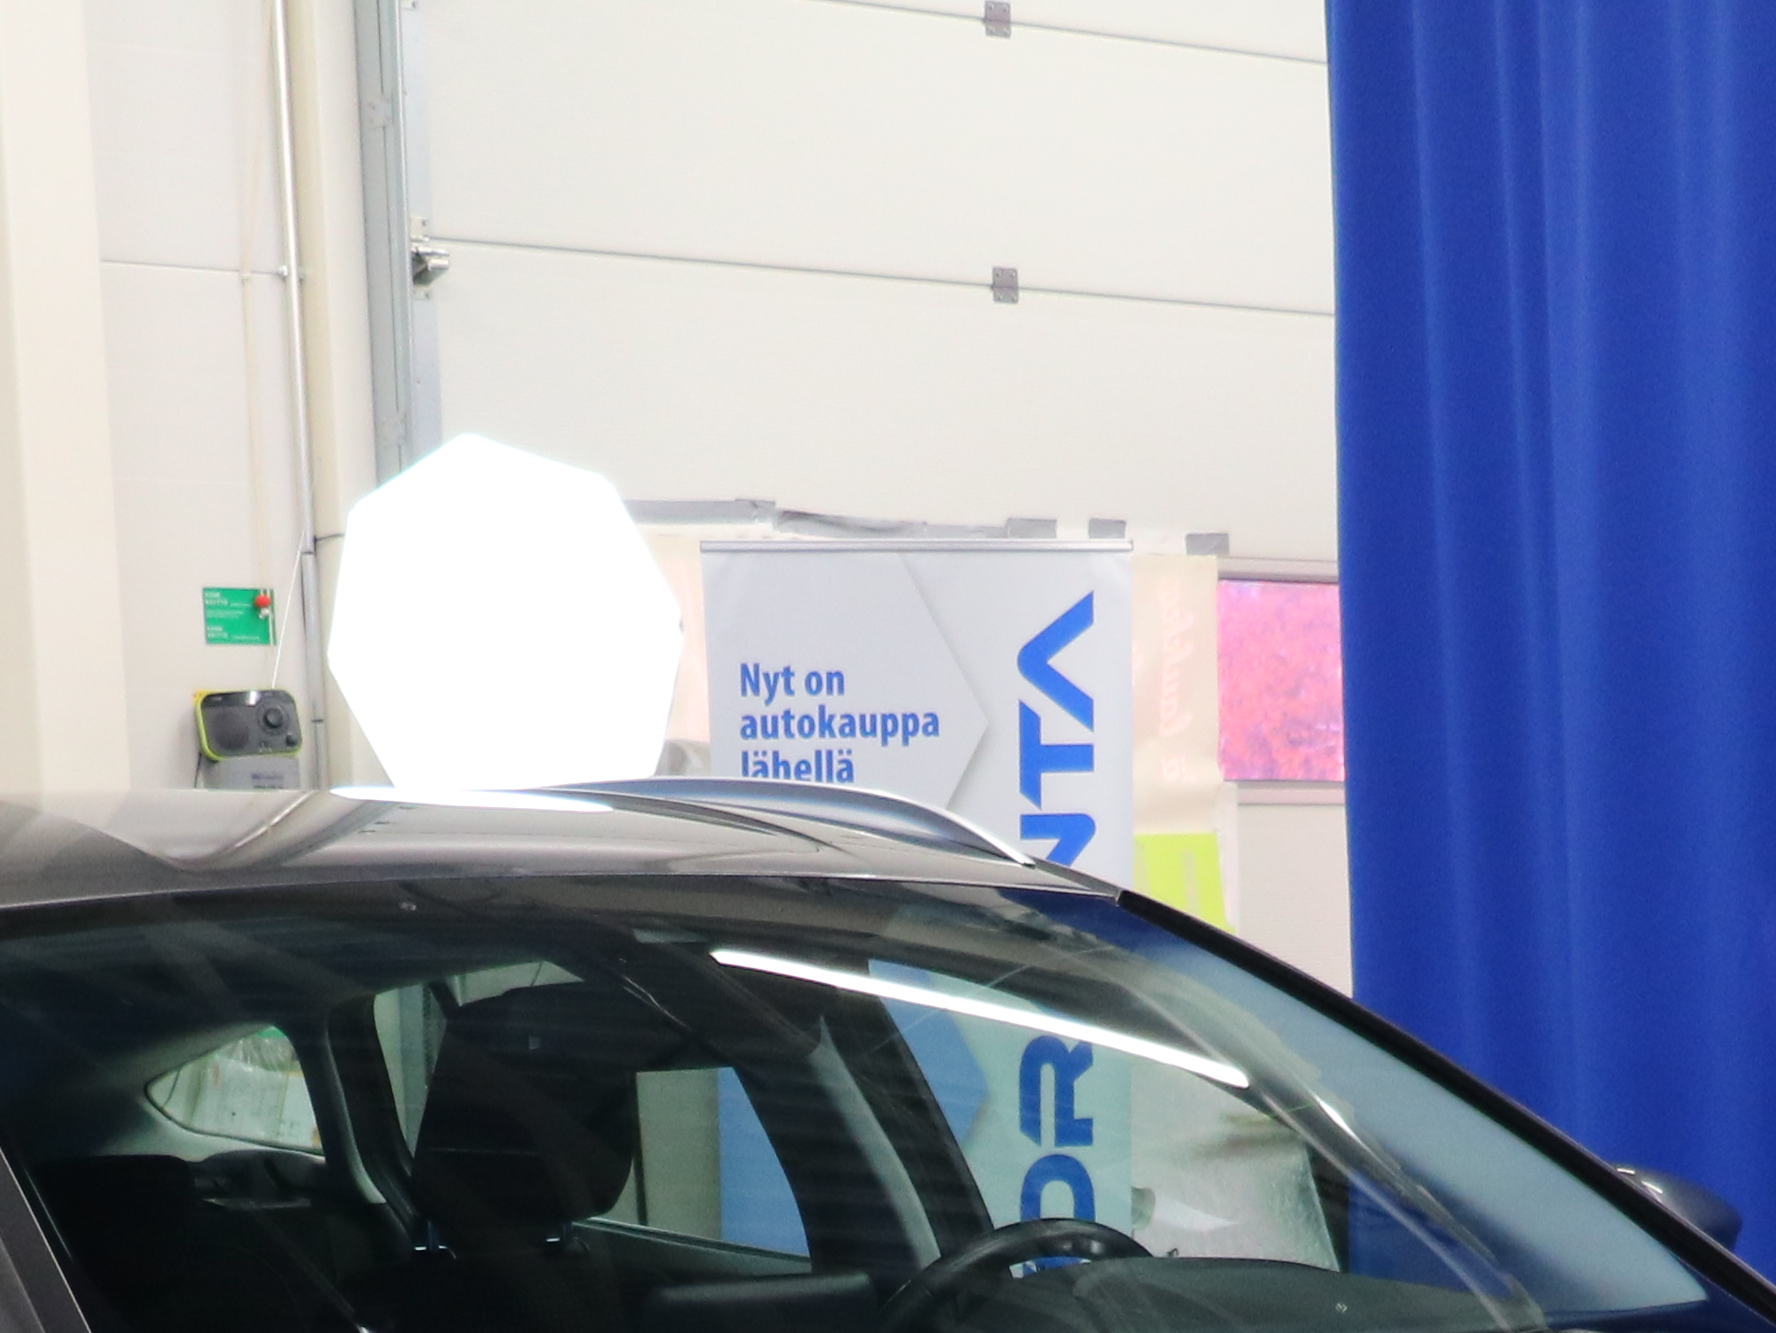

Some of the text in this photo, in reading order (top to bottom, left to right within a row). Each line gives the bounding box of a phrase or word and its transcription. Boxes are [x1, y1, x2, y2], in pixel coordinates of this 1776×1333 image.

[739, 662, 845, 707] Nyt on
[739, 703, 940, 747] autokauppa
[740, 748, 855, 783] lähellä
